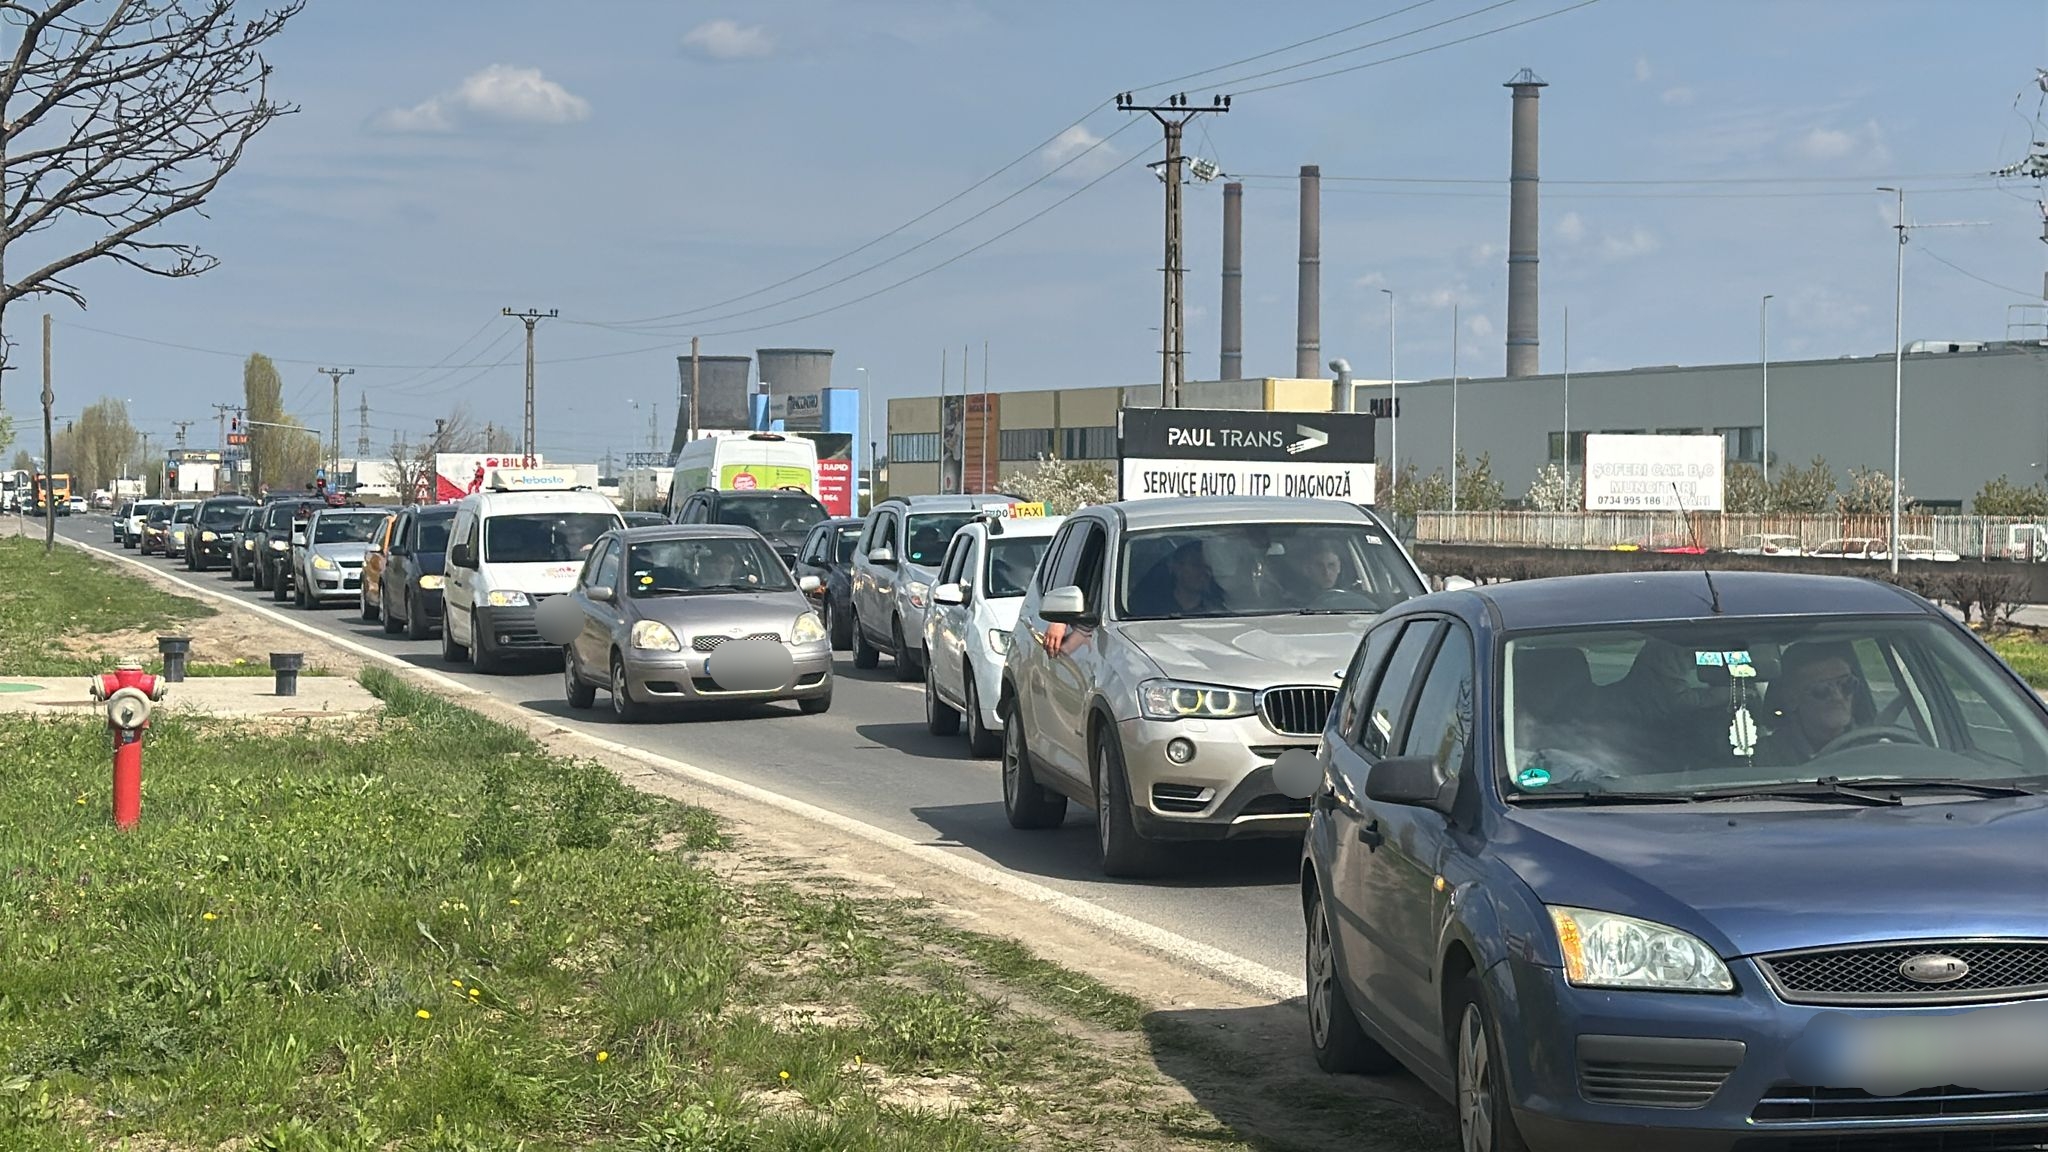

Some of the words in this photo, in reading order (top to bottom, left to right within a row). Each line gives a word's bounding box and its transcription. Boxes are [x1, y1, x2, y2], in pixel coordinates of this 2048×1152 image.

[1168, 427, 1216, 447] PAUL
[1220, 429, 1283, 448] TRANS
[1651, 463, 1685, 477] CAT.
[1143, 471, 1197, 496] SERVICE
[1200, 472, 1237, 497] AUTO
[1250, 473, 1271, 496] ITP
[1285, 470, 1351, 498] DIAGNOZĂ
[1597, 495, 1621, 505] 0734
[1623, 495, 1641, 505] 995
[1016, 507, 1043, 517] TAXI
